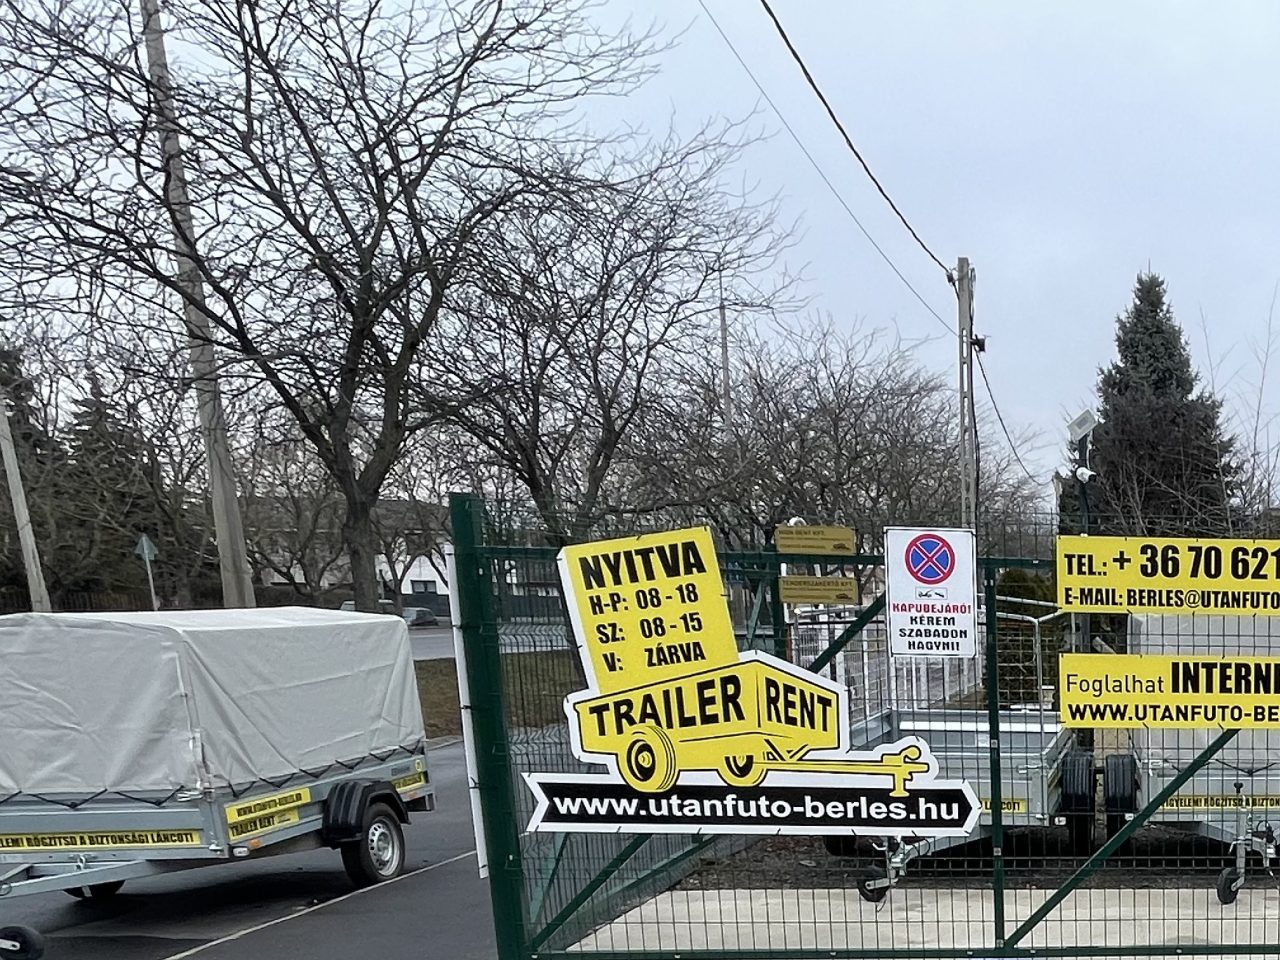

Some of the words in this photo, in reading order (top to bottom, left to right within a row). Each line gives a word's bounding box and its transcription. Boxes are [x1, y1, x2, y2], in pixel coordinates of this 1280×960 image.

[579, 541, 706, 590] NYITVA
[1064, 553, 1108, 577] TEL.:
[1140, 544, 1180, 579] 36
[1187, 545, 1223, 579] 70
[590, 593, 629, 616] H-P:
[636, 588, 661, 610] 08
[676, 584, 699, 604] 18
[892, 603, 972, 614] KAPUBEJÁRÓ!
[1064, 587, 1123, 607] E-MAIL:
[595, 622, 625, 644] SZ:
[640, 617, 665, 639] 08
[679, 612, 703, 633] 15
[899, 628, 968, 639] SZABADON
[910, 615, 956, 626] KÉREM
[602, 653, 623, 672] V:
[644, 640, 706, 667] ZÁRVA
[908, 639, 960, 651] HAGYNI!
[1066, 674, 1164, 697] Foglalhat
[589, 674, 745, 737] TRAILER
[765, 677, 832, 732] RENT
[553, 794, 959, 820] www.utanfuto-berles.hu
